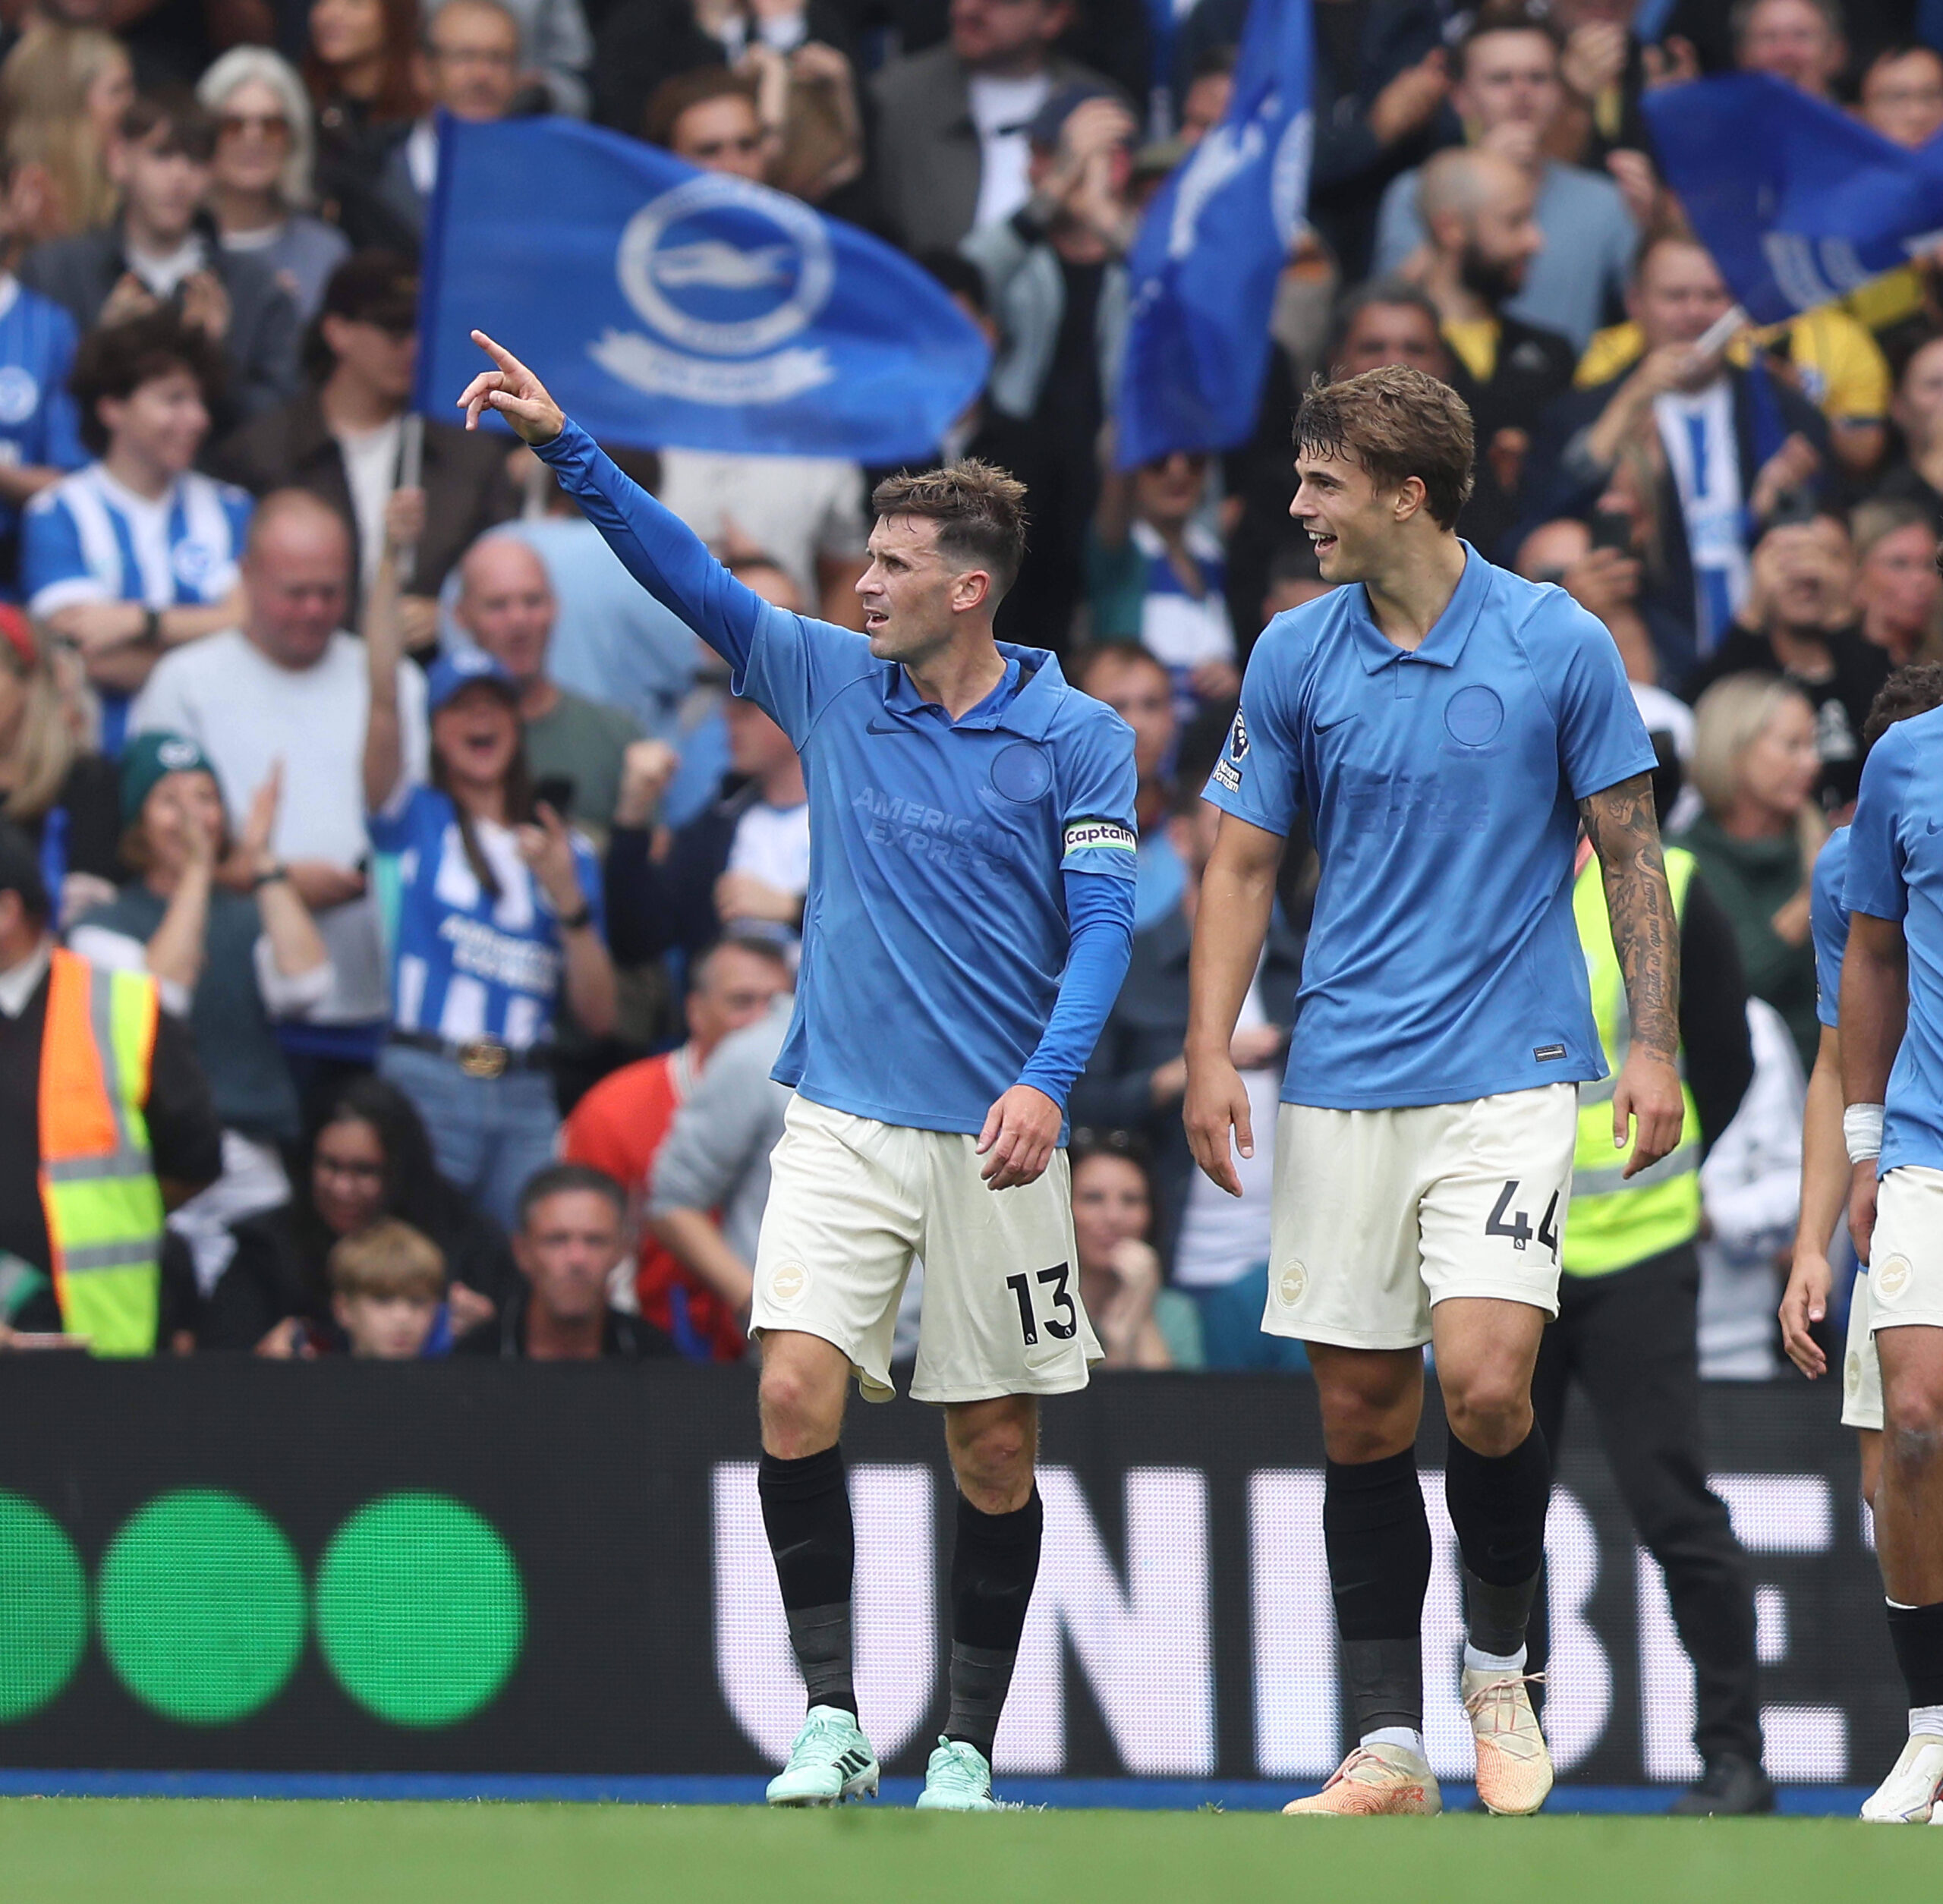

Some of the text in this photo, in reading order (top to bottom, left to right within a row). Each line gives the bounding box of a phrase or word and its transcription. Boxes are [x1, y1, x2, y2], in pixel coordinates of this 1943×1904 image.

[851, 786, 1019, 858] AMERICAN
[1485, 1180, 1559, 1266] 44
[1006, 1260, 1078, 1345] 13
[710, 1460, 1875, 1785] UNIBE
